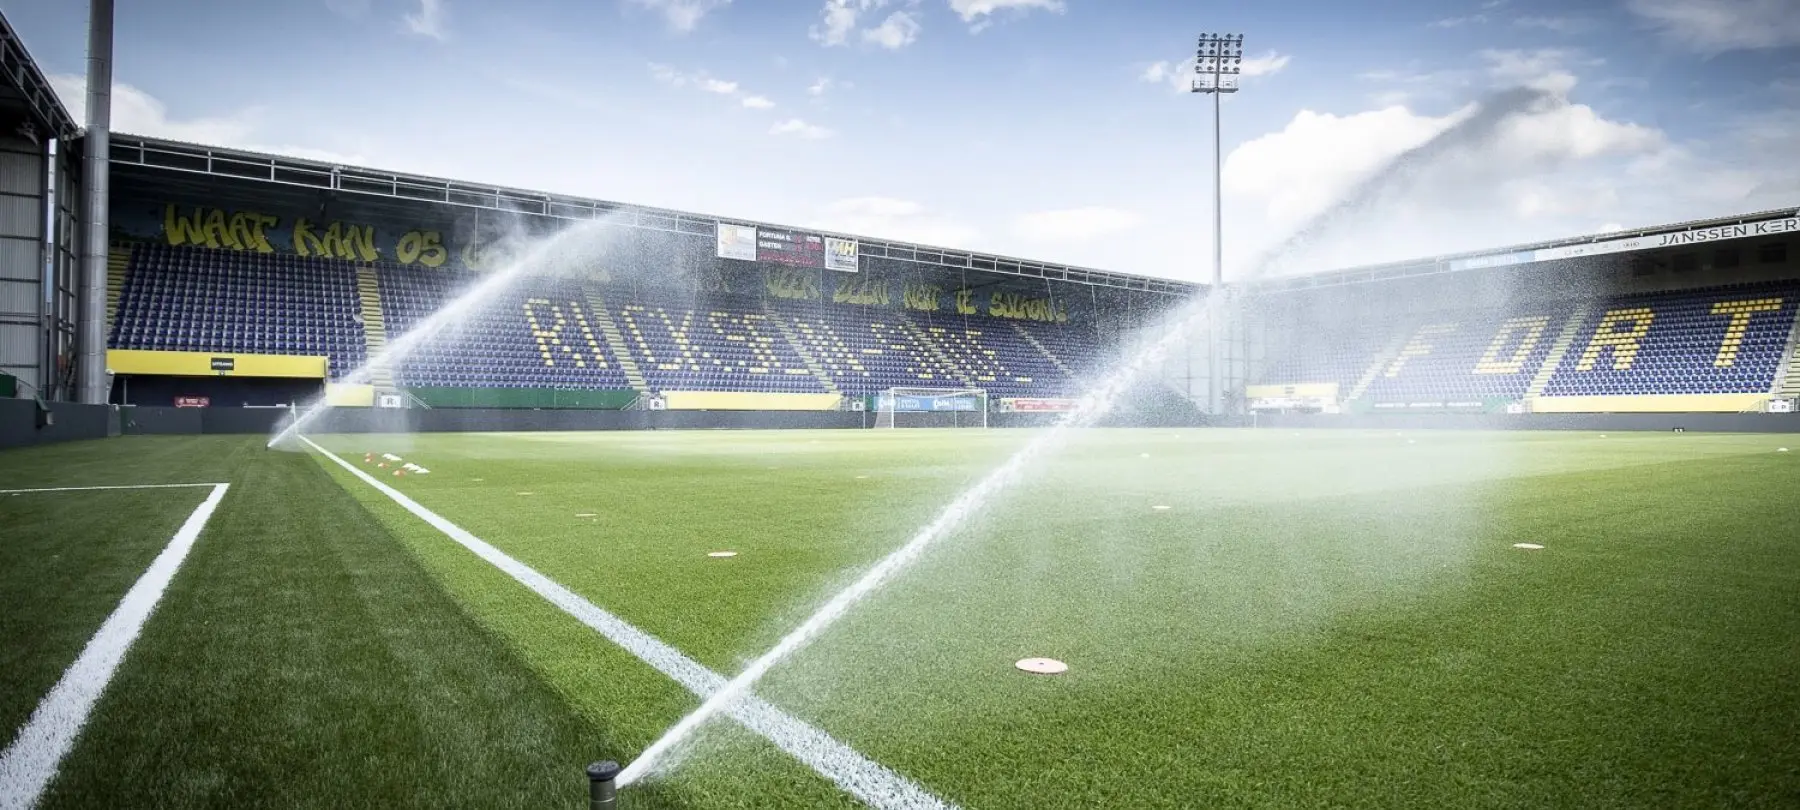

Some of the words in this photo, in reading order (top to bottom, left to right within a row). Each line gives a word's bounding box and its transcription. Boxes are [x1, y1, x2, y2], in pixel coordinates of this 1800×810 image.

[164, 203, 279, 253] WAAT
[293, 216, 382, 262] KAN
[396, 230, 447, 267] OS
[1659, 225, 1747, 246] JANSSEN
